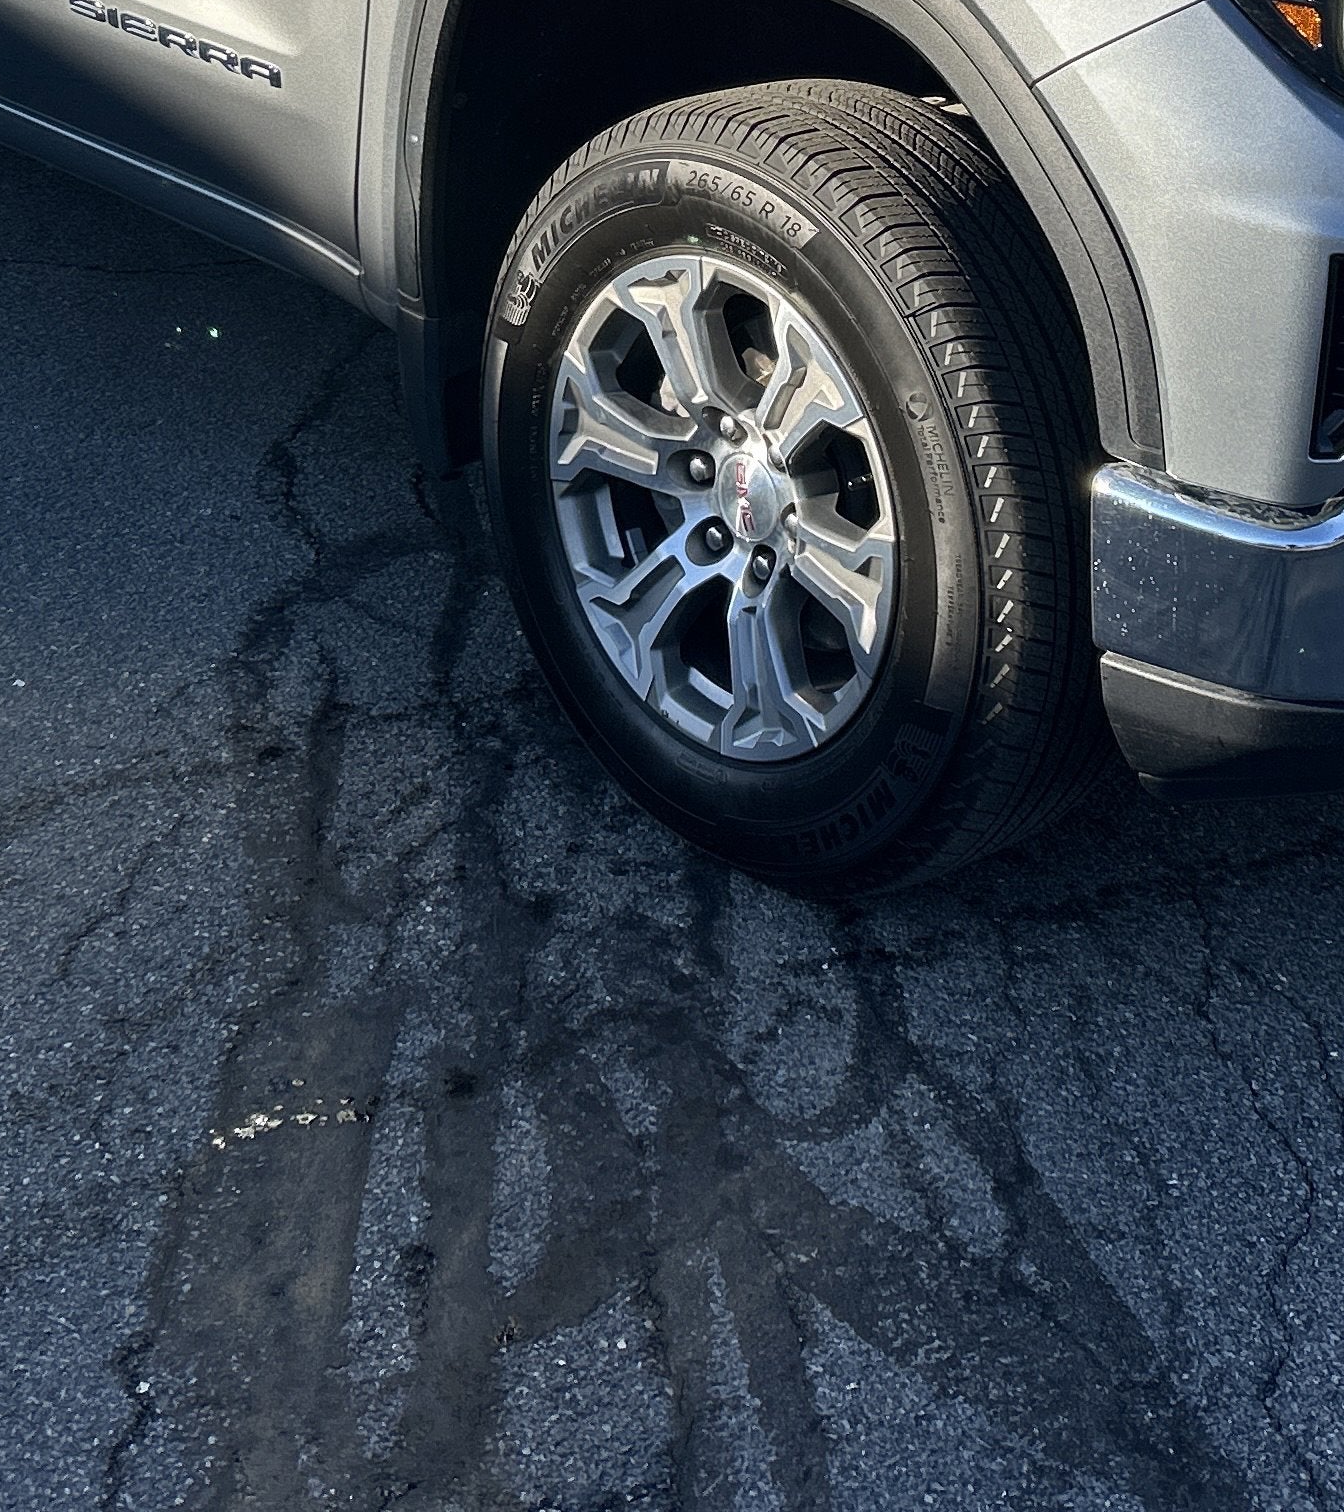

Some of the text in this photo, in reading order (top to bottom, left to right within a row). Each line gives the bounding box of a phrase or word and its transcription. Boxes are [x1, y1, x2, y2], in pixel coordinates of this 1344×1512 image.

[686, 170, 756, 207] 265/65
[758, 200, 776, 220] R
[780, 214, 803, 239] 18
[926, 425, 955, 497] MICHELIN
